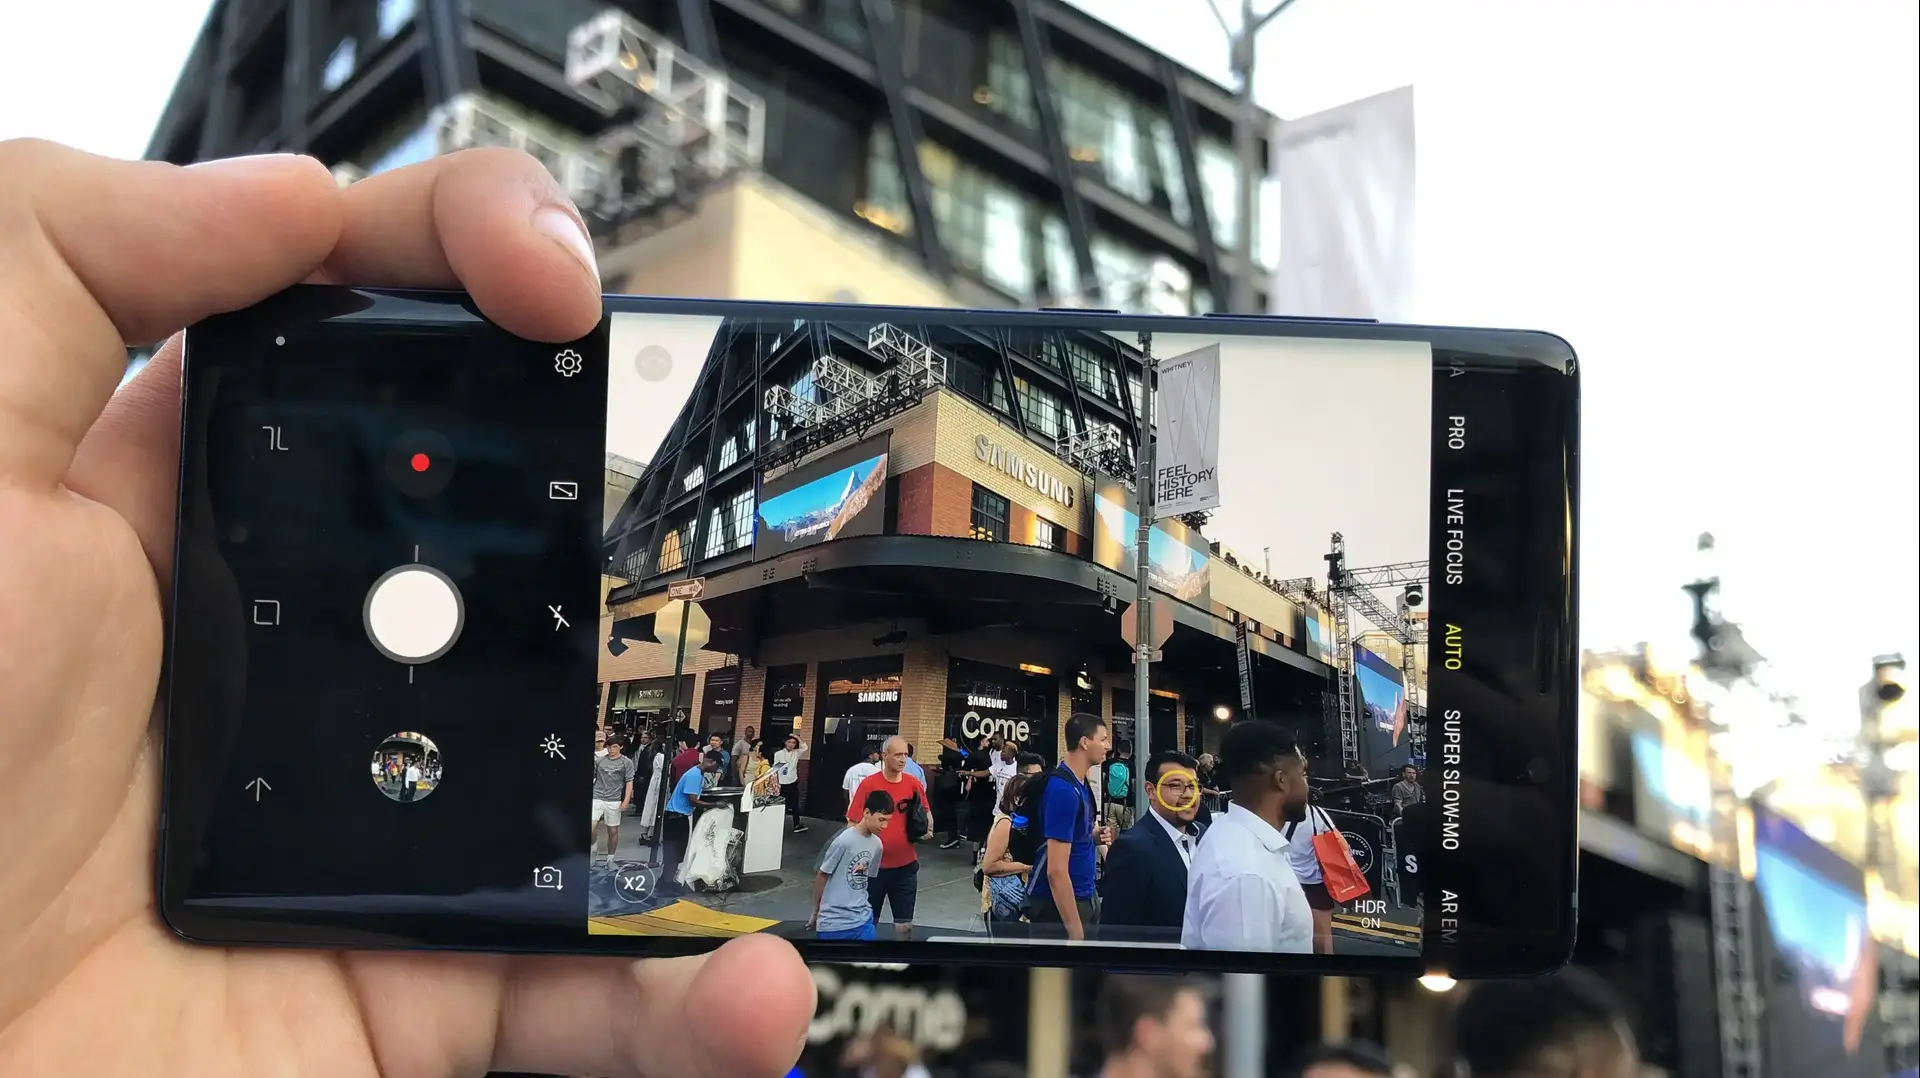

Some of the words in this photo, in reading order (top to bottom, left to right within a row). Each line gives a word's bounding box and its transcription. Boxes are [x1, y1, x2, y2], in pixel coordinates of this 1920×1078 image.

[1161, 360, 1193, 374] WHITNEY
[1448, 416, 1466, 450] PRO
[974, 434, 1074, 509] SAMSUNG
[1158, 464, 1192, 480] FEEL
[1158, 467, 1214, 491] HISTORY
[1157, 485, 1193, 503] HERE
[1447, 489, 1464, 525] LIVE
[1446, 529, 1464, 585] FOCUS
[670, 586, 683, 596] ONE
[1444, 623, 1462, 671] AUTO
[857, 691, 898, 703] SAMSUNG
[967, 695, 1008, 710] SAMSUNG
[962, 711, 1030, 742] Come
[1443, 709, 1461, 765] SUPER
[1442, 769, 1460, 851] SLOW-MO
[1354, 900, 1387, 914] HDR
[1441, 889, 1458, 914] AR
[1361, 917, 1381, 929] ON
